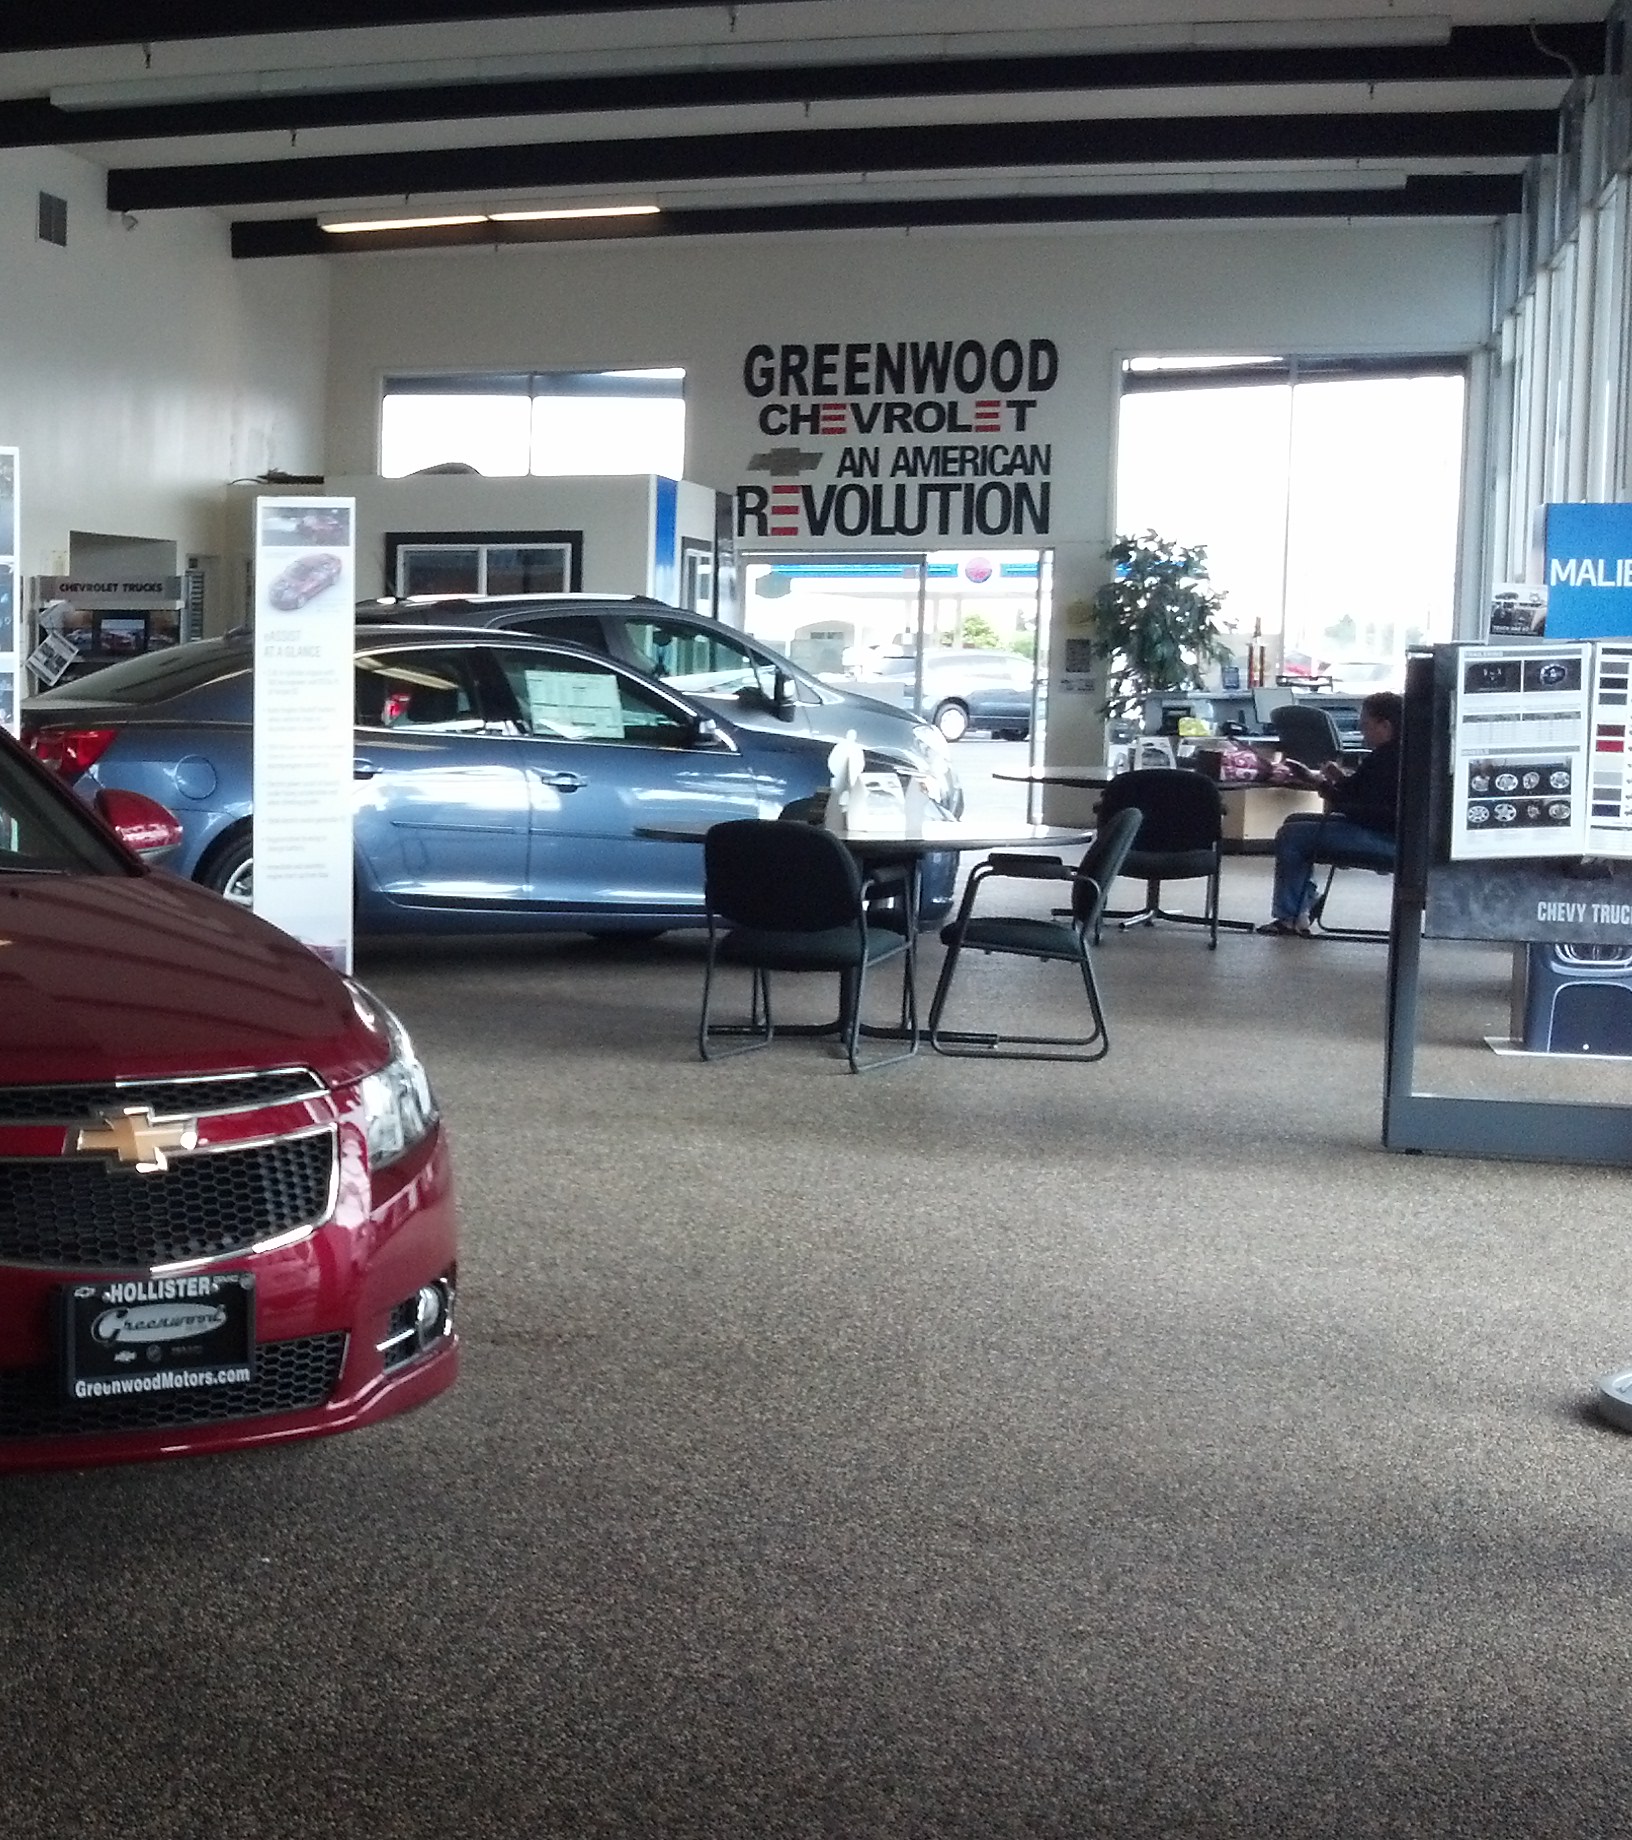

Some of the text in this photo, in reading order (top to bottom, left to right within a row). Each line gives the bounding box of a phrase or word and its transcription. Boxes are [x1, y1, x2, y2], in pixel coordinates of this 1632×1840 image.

[743, 339, 1059, 397] GREENWOOD
[759, 400, 1037, 435] CHEVROLET
[836, 444, 1051, 478] AN AMERICAN
[736, 482, 1051, 536] REVOLUTION
[59, 583, 163, 593] CHEVROLET TRUCKS
[286, 646, 320, 658] GLANCE
[1537, 901, 1632, 925] CHEVY TRUC
[111, 1276, 210, 1303] HOLLISTER
[91, 1303, 226, 1344] Greenwood
[75, 1368, 250, 1398] GreenwoodMotors.com
